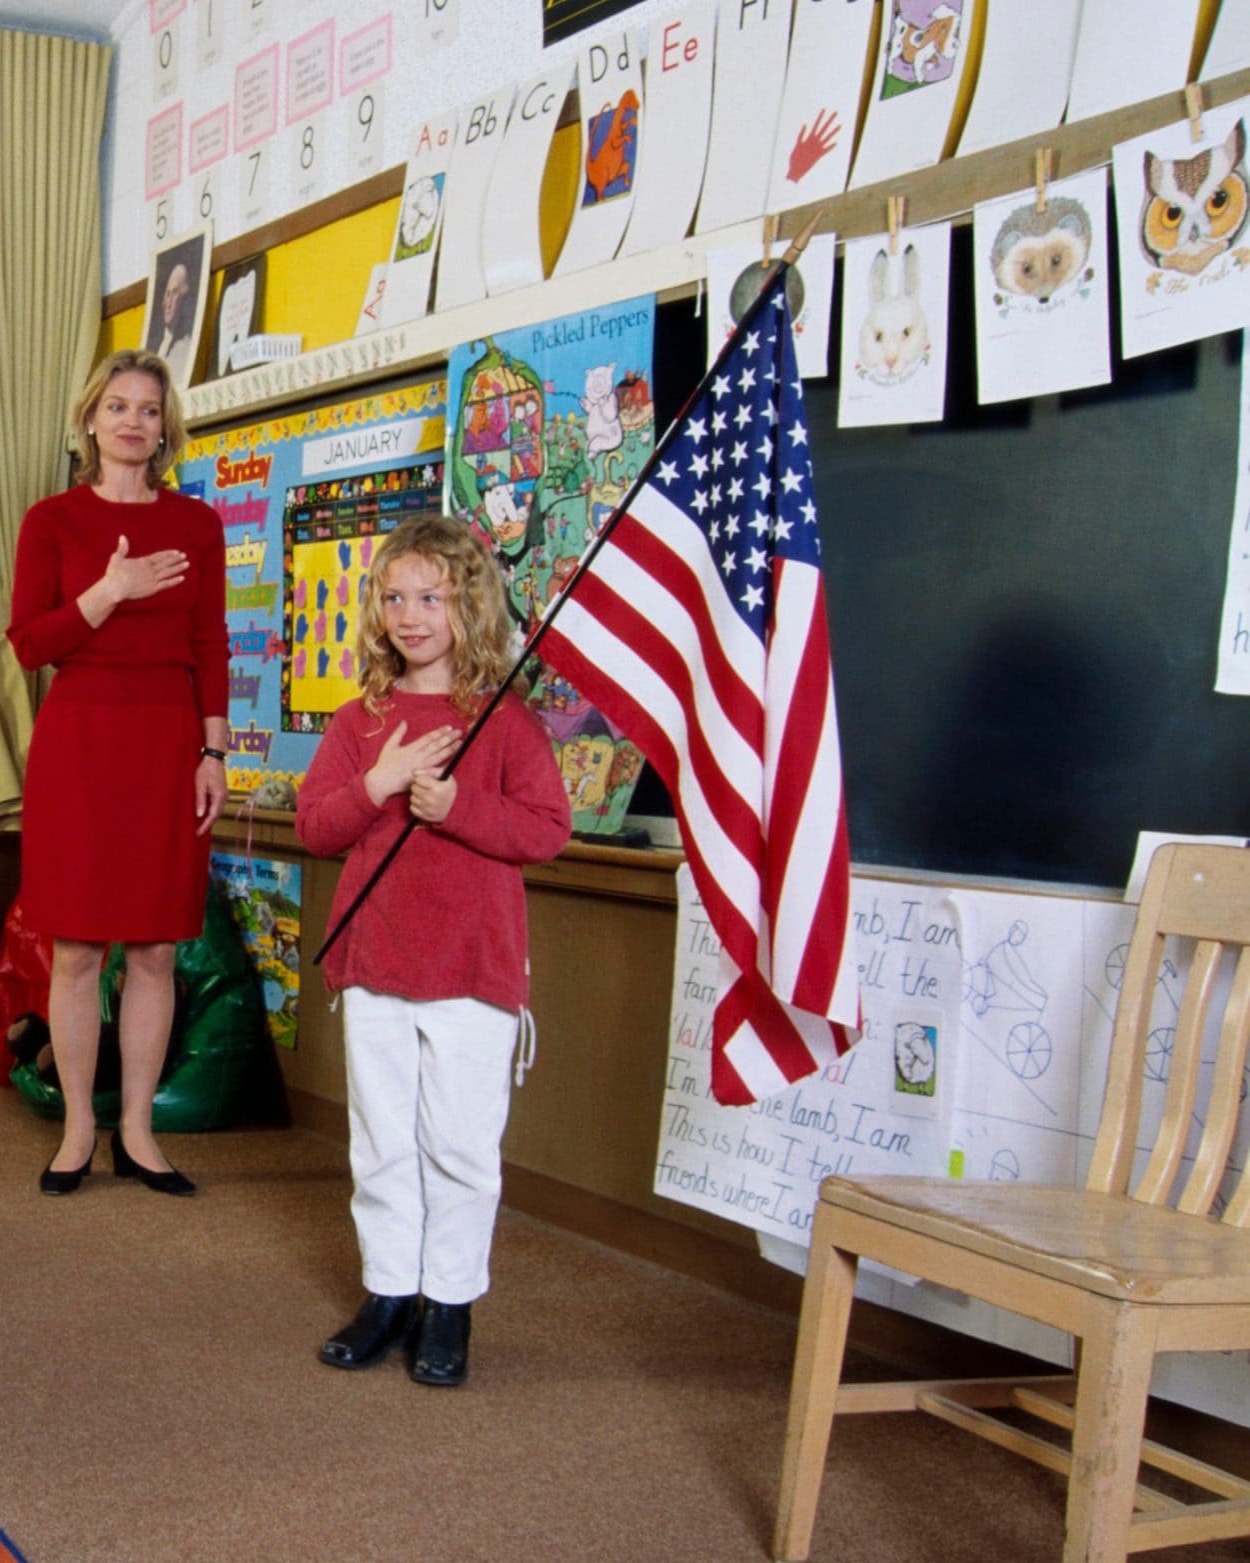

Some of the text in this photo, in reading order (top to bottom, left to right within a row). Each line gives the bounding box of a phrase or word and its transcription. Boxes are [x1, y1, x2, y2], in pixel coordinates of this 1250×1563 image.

[159, 31, 172, 69] 0
[589, 32, 630, 84] Dd
[662, 21, 700, 73] Ee
[358, 95, 375, 143] 9
[521, 81, 556, 121] Cc
[464, 102, 498, 145] Bb
[301, 126, 314, 169] 8
[249, 151, 262, 196] 7
[156, 199, 168, 239] 5
[200, 177, 213, 219] 6
[531, 305, 650, 354] Pickled Peppers
[324, 428, 403, 465] JANUARY
[215, 450, 272, 490] Sunday
[213, 491, 270, 533] Monday
[901, 957, 939, 999] the
[665, 1056, 699, 1097] I'm
[789, 1089, 841, 1143] lamb,
[845, 1104, 877, 1145] I
[869, 1130, 914, 1157] am
[665, 1103, 854, 1185] This is how I tell
[658, 1150, 719, 1199] friends
[762, 1181, 794, 1225] I
